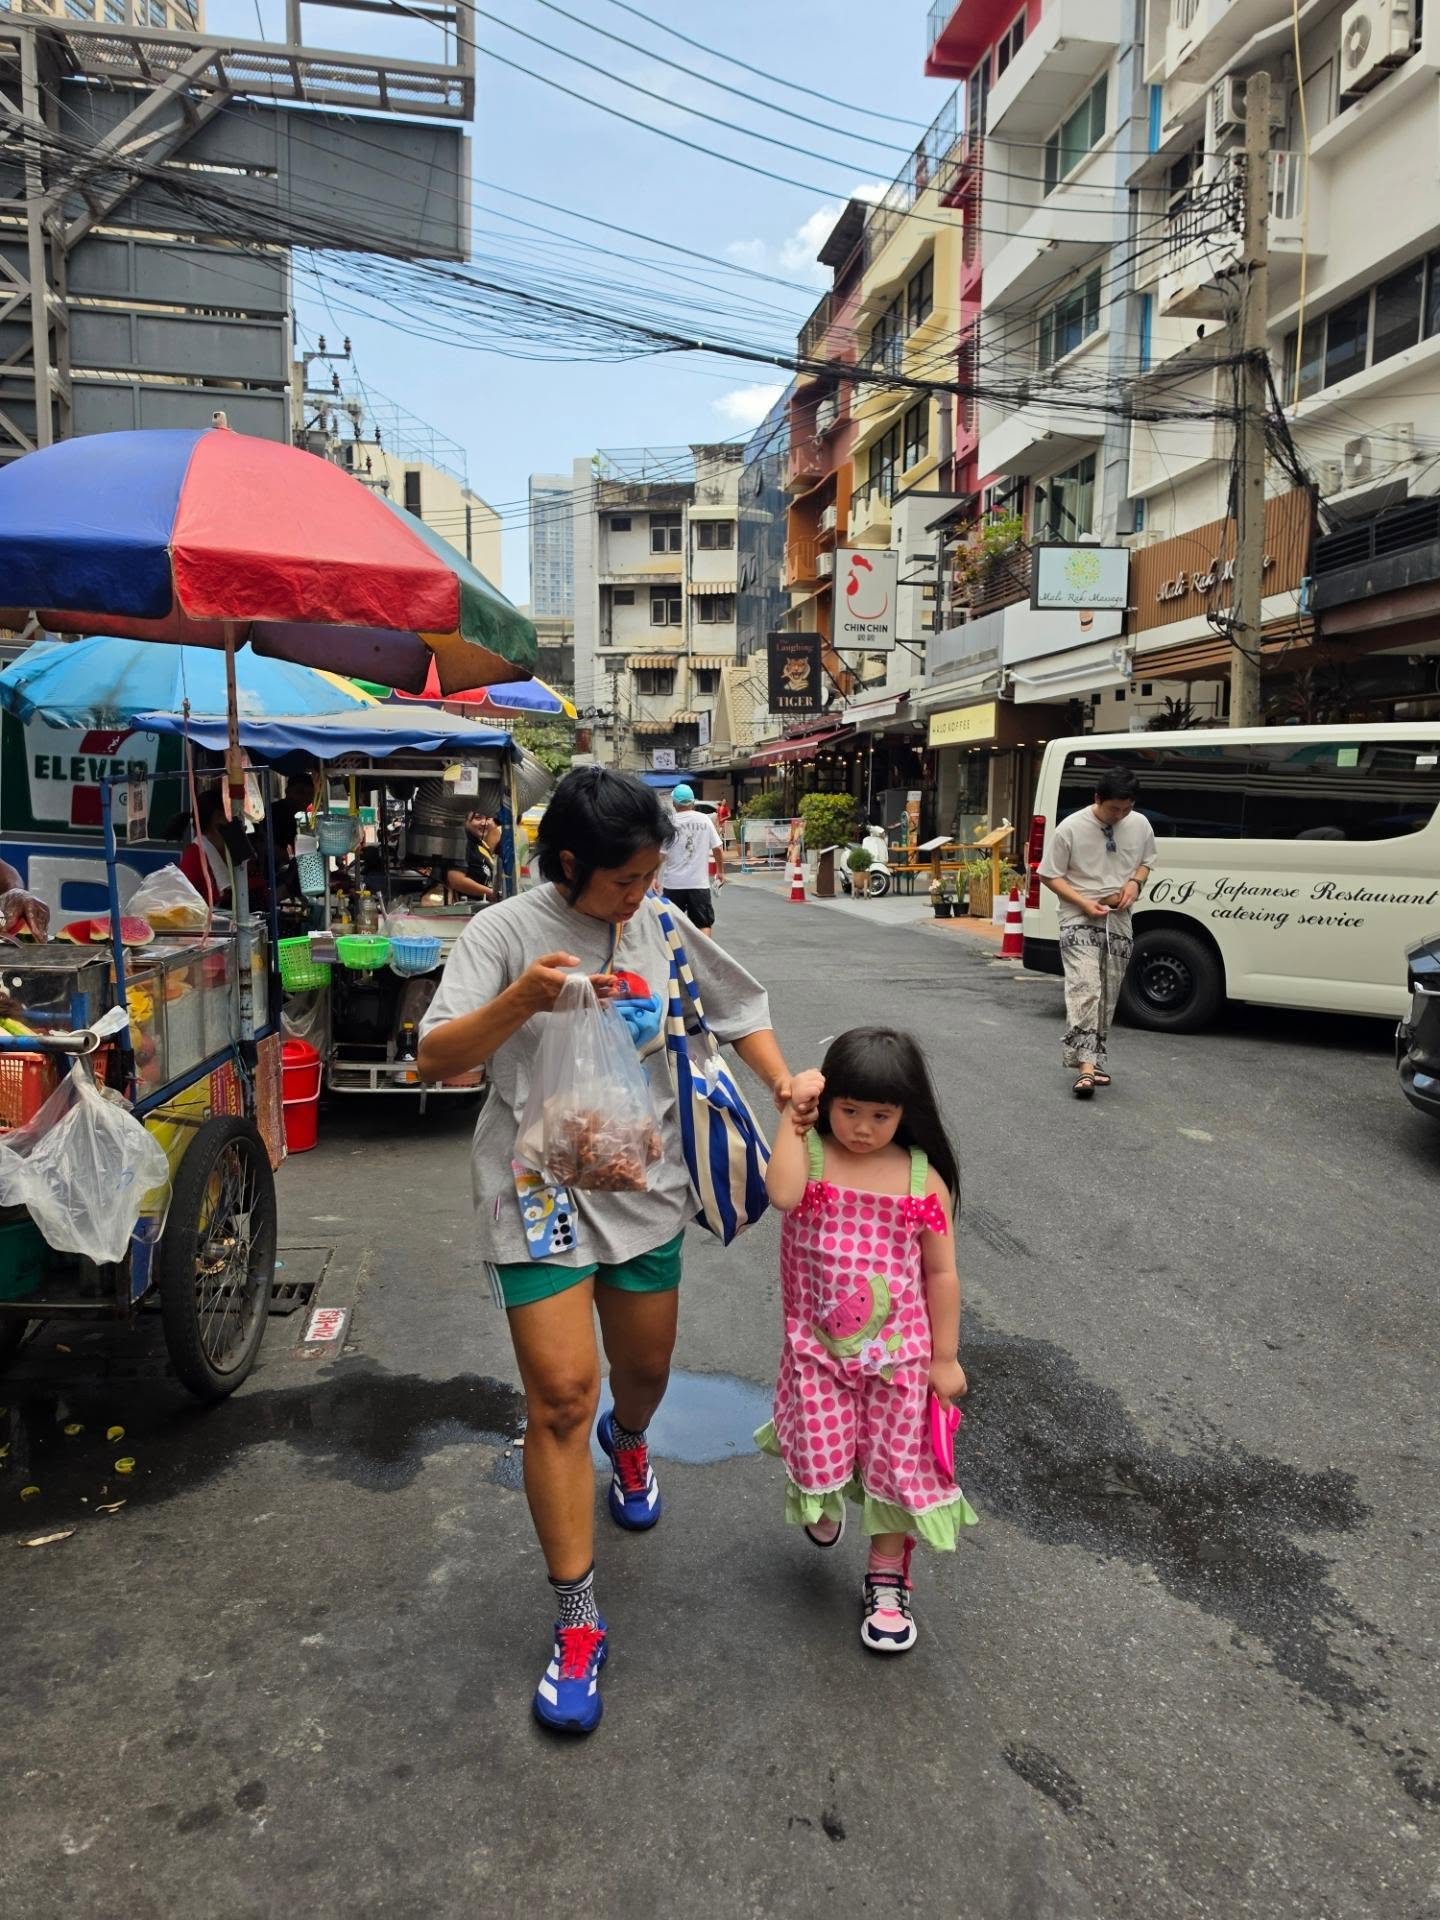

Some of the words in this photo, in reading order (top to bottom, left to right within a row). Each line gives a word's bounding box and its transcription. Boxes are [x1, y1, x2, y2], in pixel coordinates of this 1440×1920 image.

[1156, 571, 1185, 602] Mali
[776, 696, 813, 707] TIGER
[677, 822, 708, 831] MIRI
[1206, 876, 1300, 902] Japanese
[1310, 881, 1439, 906] Restaurant
[1211, 906, 1291, 930] catering
[1298, 911, 1364, 929] service
